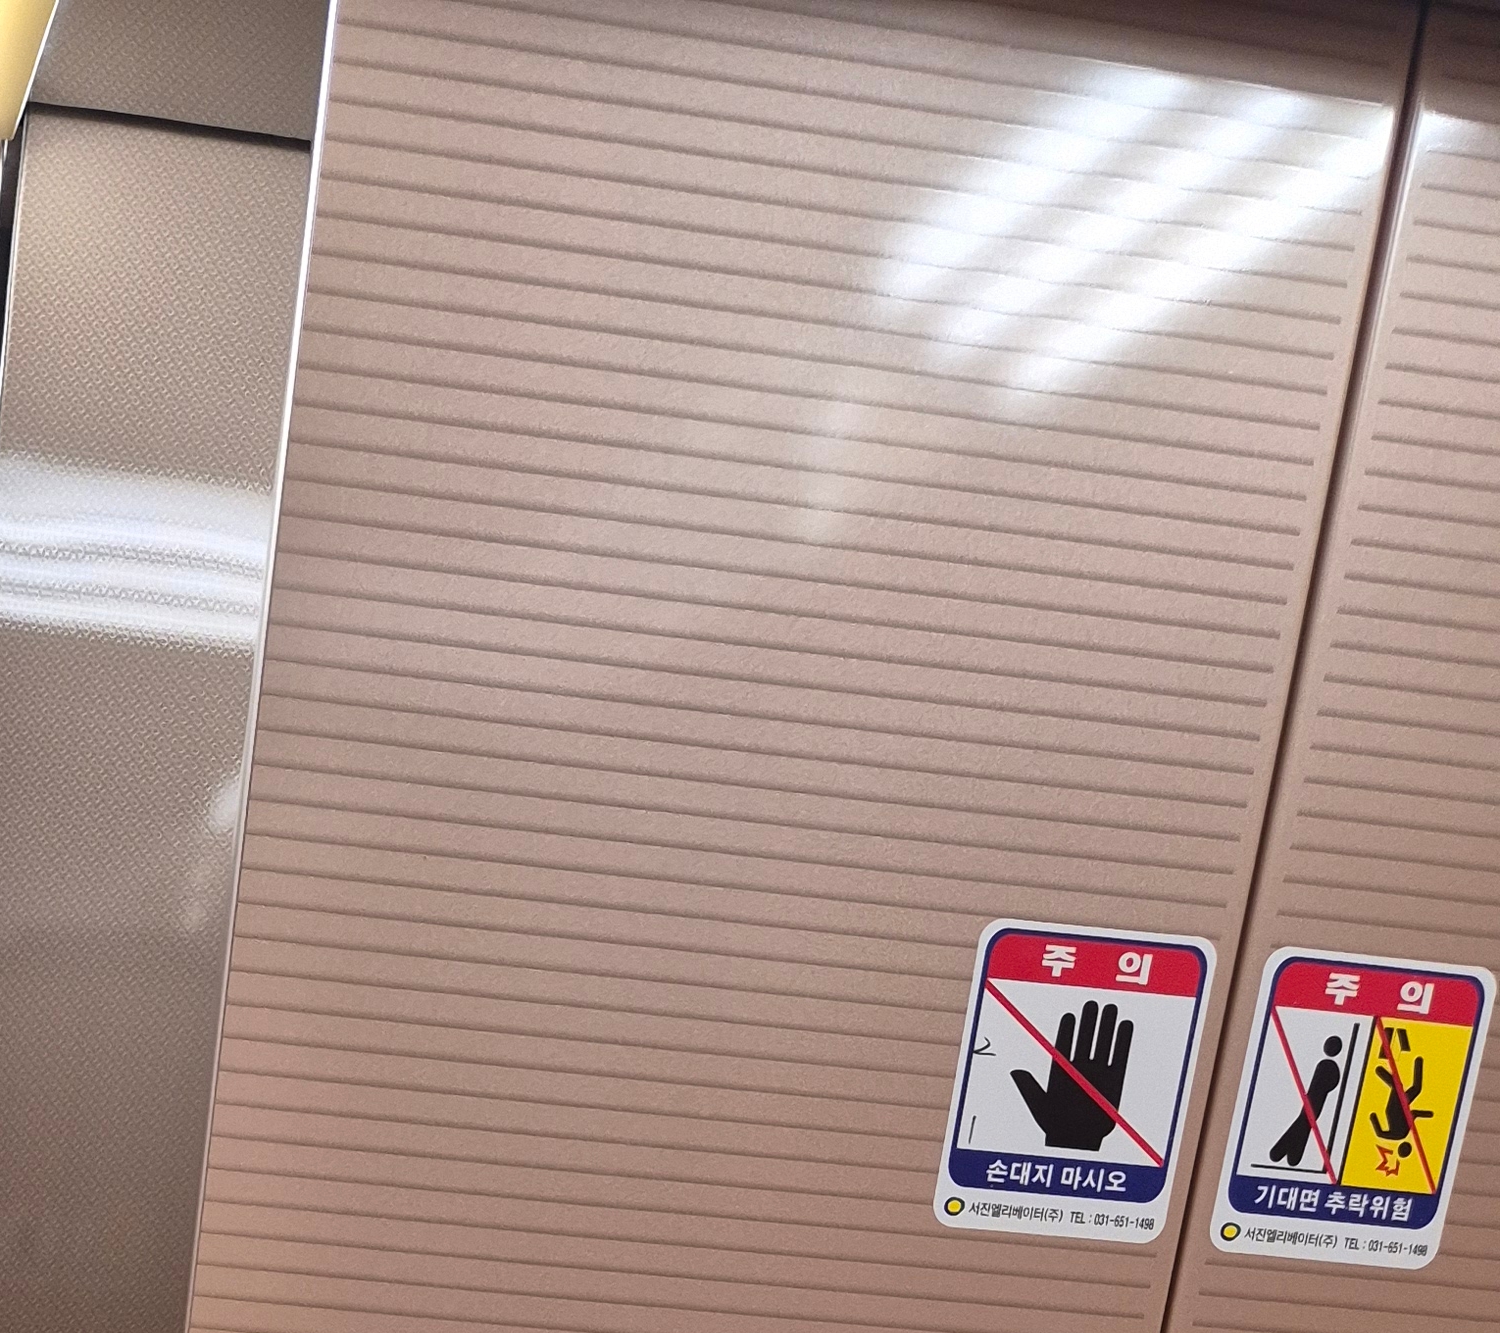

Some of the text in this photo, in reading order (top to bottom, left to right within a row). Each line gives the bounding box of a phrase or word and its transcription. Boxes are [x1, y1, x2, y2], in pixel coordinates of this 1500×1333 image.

[985, 1159, 1127, 1193] 손대지 마시오
[968, 1201, 1064, 1223] 서진엘리베이터(주)
[1254, 1184, 1413, 1222] 기대면 추락위험
[1244, 1226, 1338, 1249] 서진엘리베이터(주)
